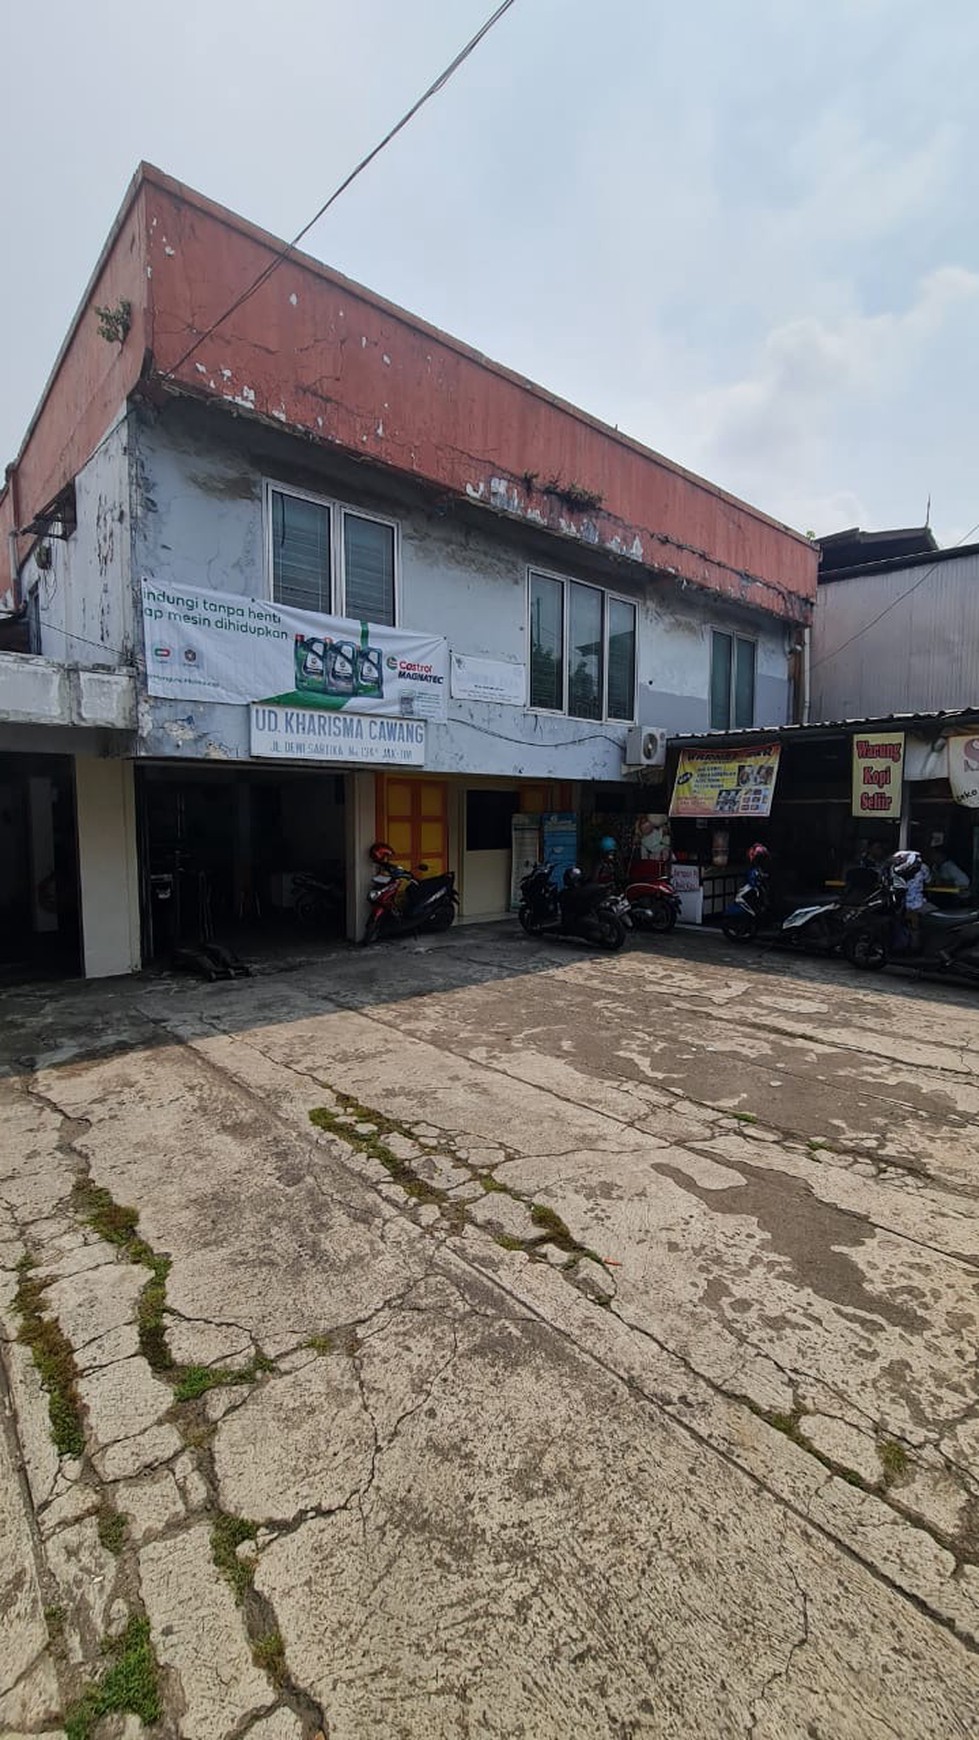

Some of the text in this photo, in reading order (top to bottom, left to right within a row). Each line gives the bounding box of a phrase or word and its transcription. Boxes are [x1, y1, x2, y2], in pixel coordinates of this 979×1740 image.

[203, 599, 245, 617] tanpa
[248, 608, 282, 624] henti
[167, 611, 211, 627] mesin
[214, 617, 288, 640] dihidupkan
[398, 671, 444, 685] MAGNATEC
[399, 660, 433, 674] Castrol
[254, 708, 424, 744] UD. KHARISMA CAWANG
[856, 740, 902, 763] Warung
[862, 765, 892, 789] Kopi
